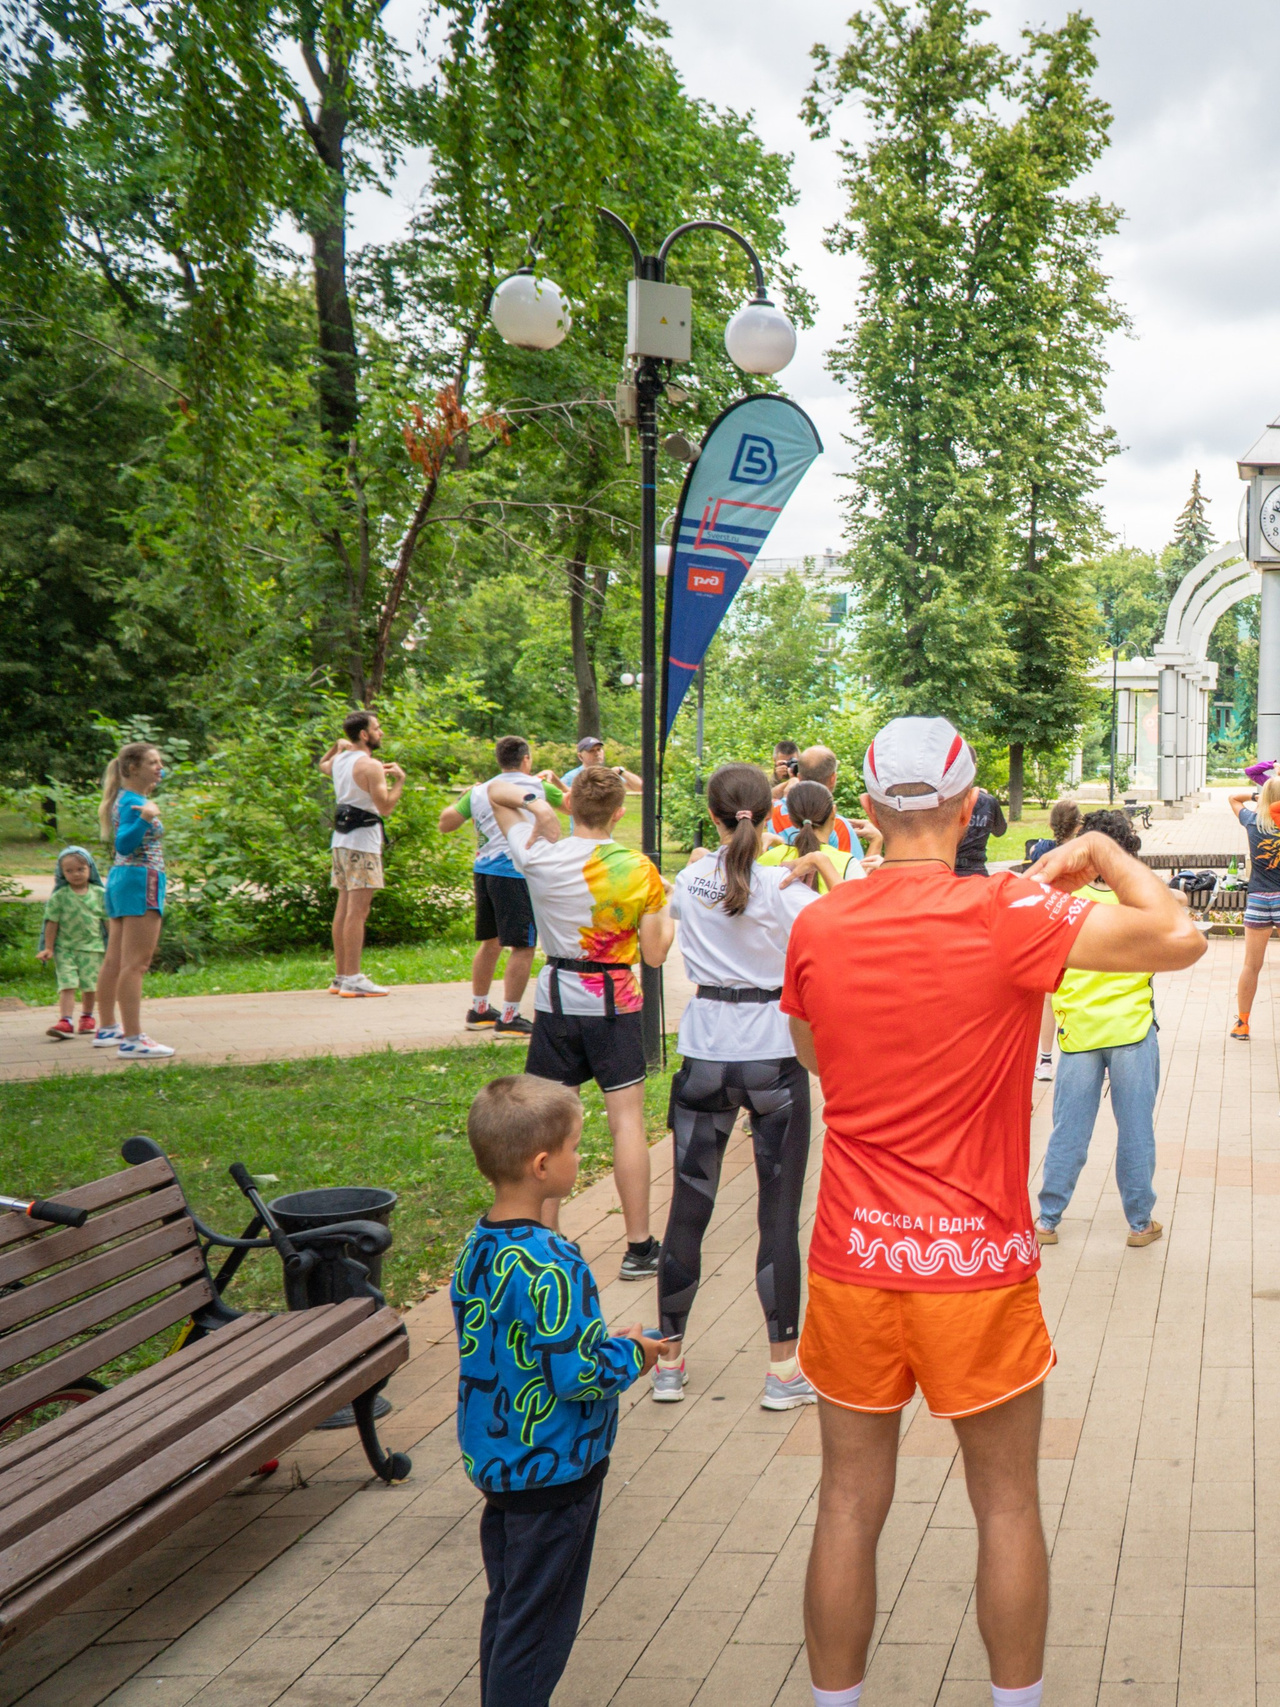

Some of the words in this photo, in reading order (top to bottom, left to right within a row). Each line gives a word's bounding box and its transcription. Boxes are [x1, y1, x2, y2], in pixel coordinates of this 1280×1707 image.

[1269, 514, 1276, 523] 9
[1273, 527, 1279, 536] 8
[853, 1207, 924, 1231] МОСКВА
[939, 1216, 986, 1234] ВДНХ
